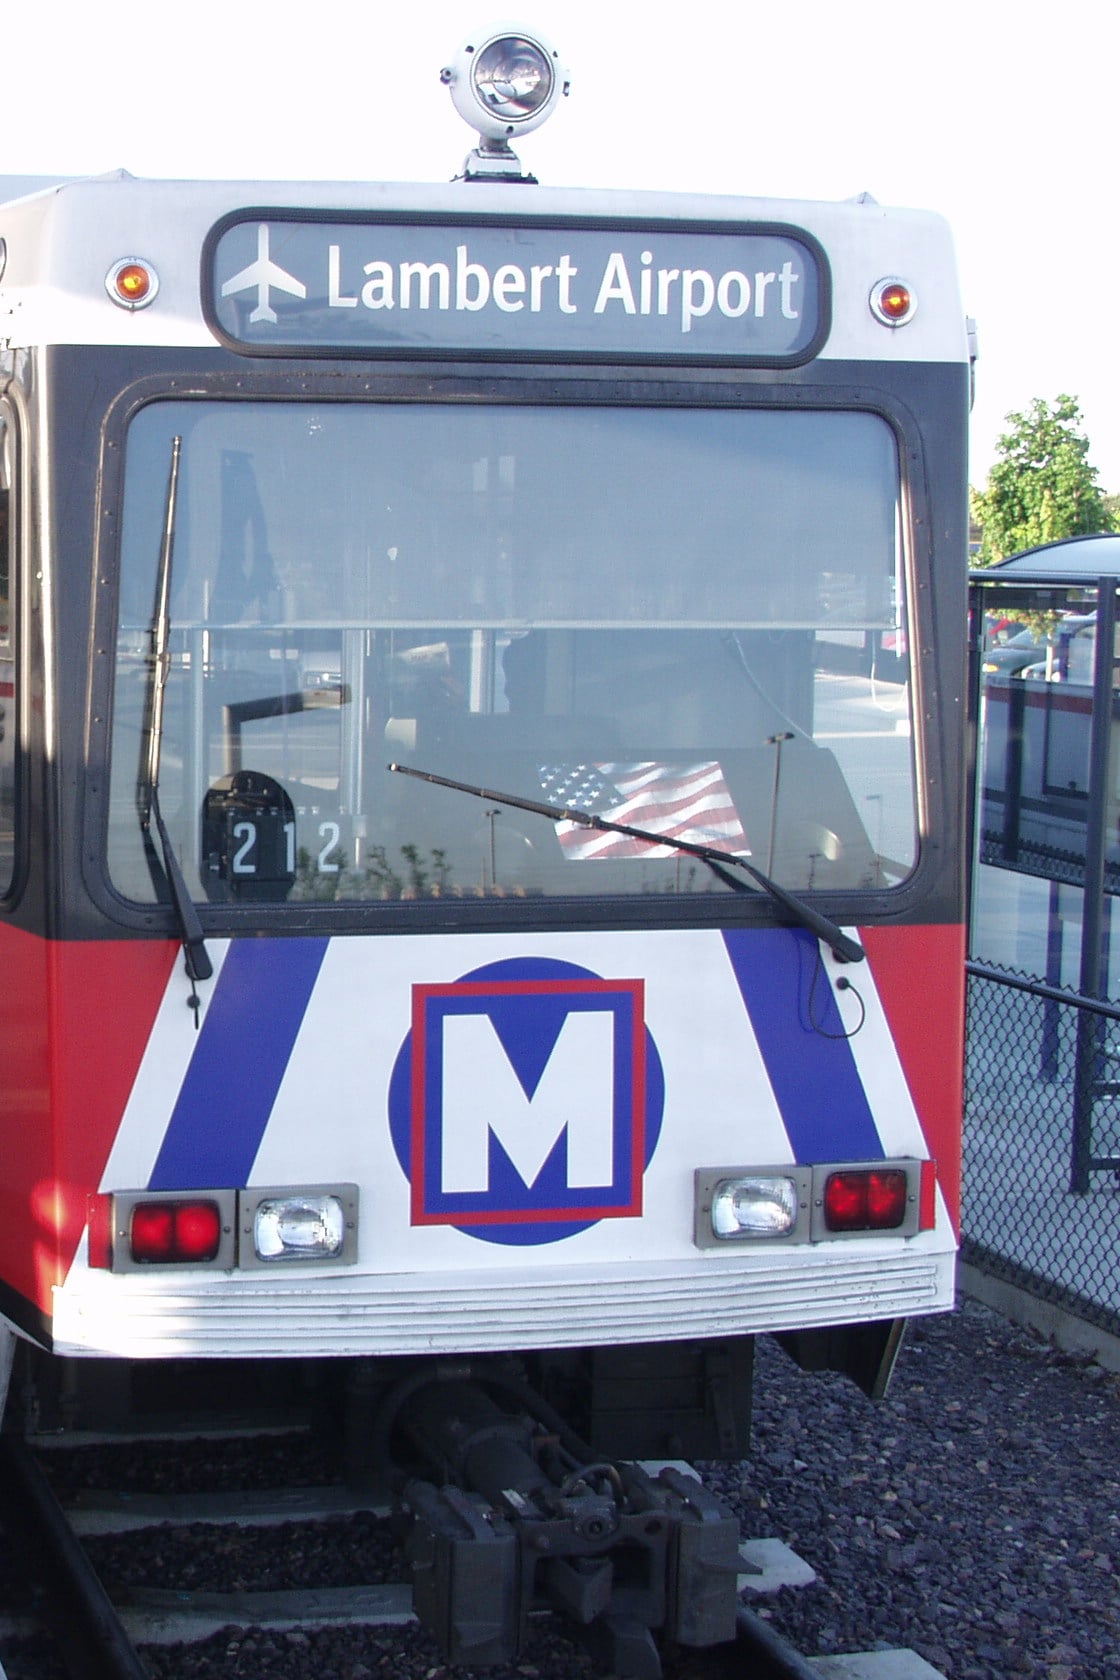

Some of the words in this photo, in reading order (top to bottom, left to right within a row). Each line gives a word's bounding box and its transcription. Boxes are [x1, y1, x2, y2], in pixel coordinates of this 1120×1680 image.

[327, 244, 578, 313] Lambert
[593, 250, 799, 333] Airport
[441, 1010, 614, 1194] M
